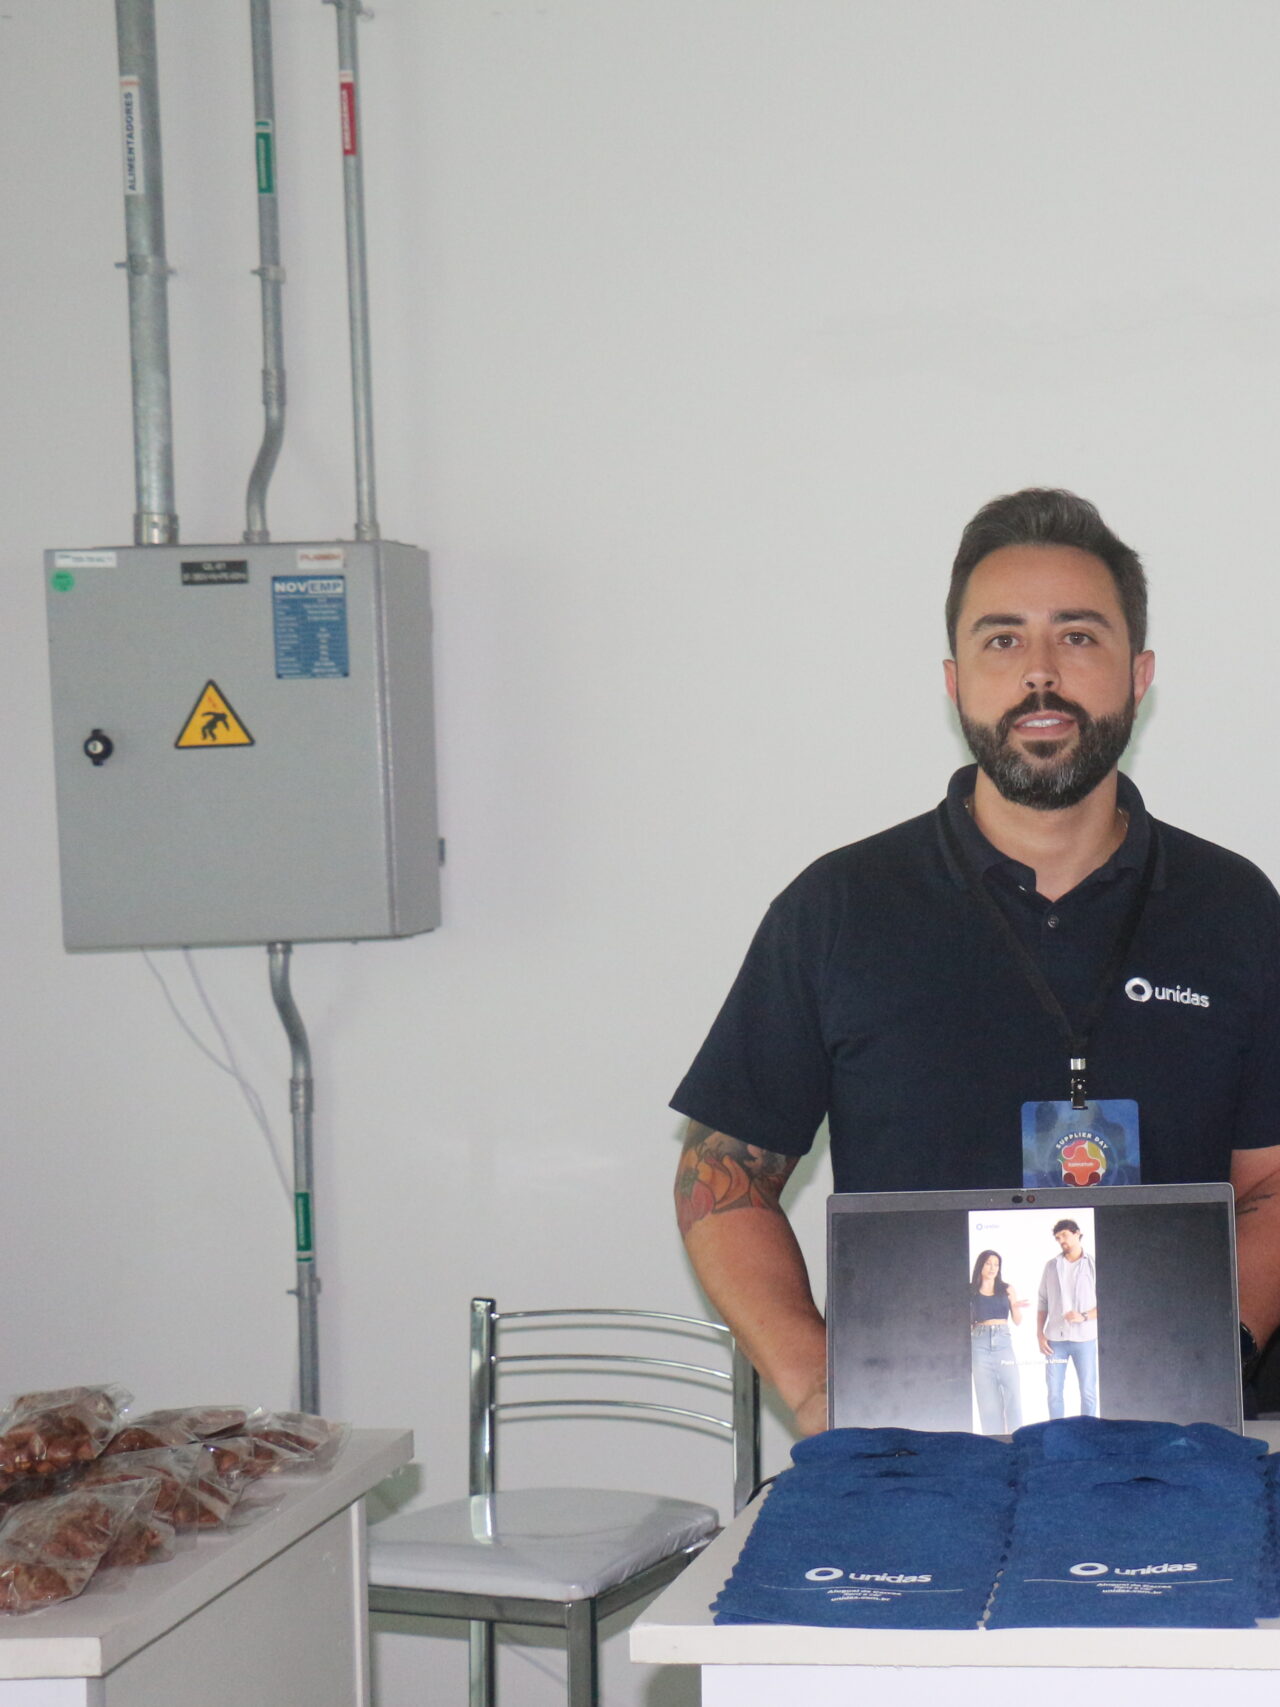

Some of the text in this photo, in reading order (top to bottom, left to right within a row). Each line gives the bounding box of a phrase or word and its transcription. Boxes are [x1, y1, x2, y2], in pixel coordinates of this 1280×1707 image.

[124, 91, 136, 191] ALIMENTADORES
[274, 580, 343, 593] NOVEMP
[1154, 985, 1210, 1008] unidas
[1056, 1132, 1109, 1150] SUPPLIER DAY
[1114, 1562, 1198, 1576] unidas
[848, 1572, 932, 1584] unidas
